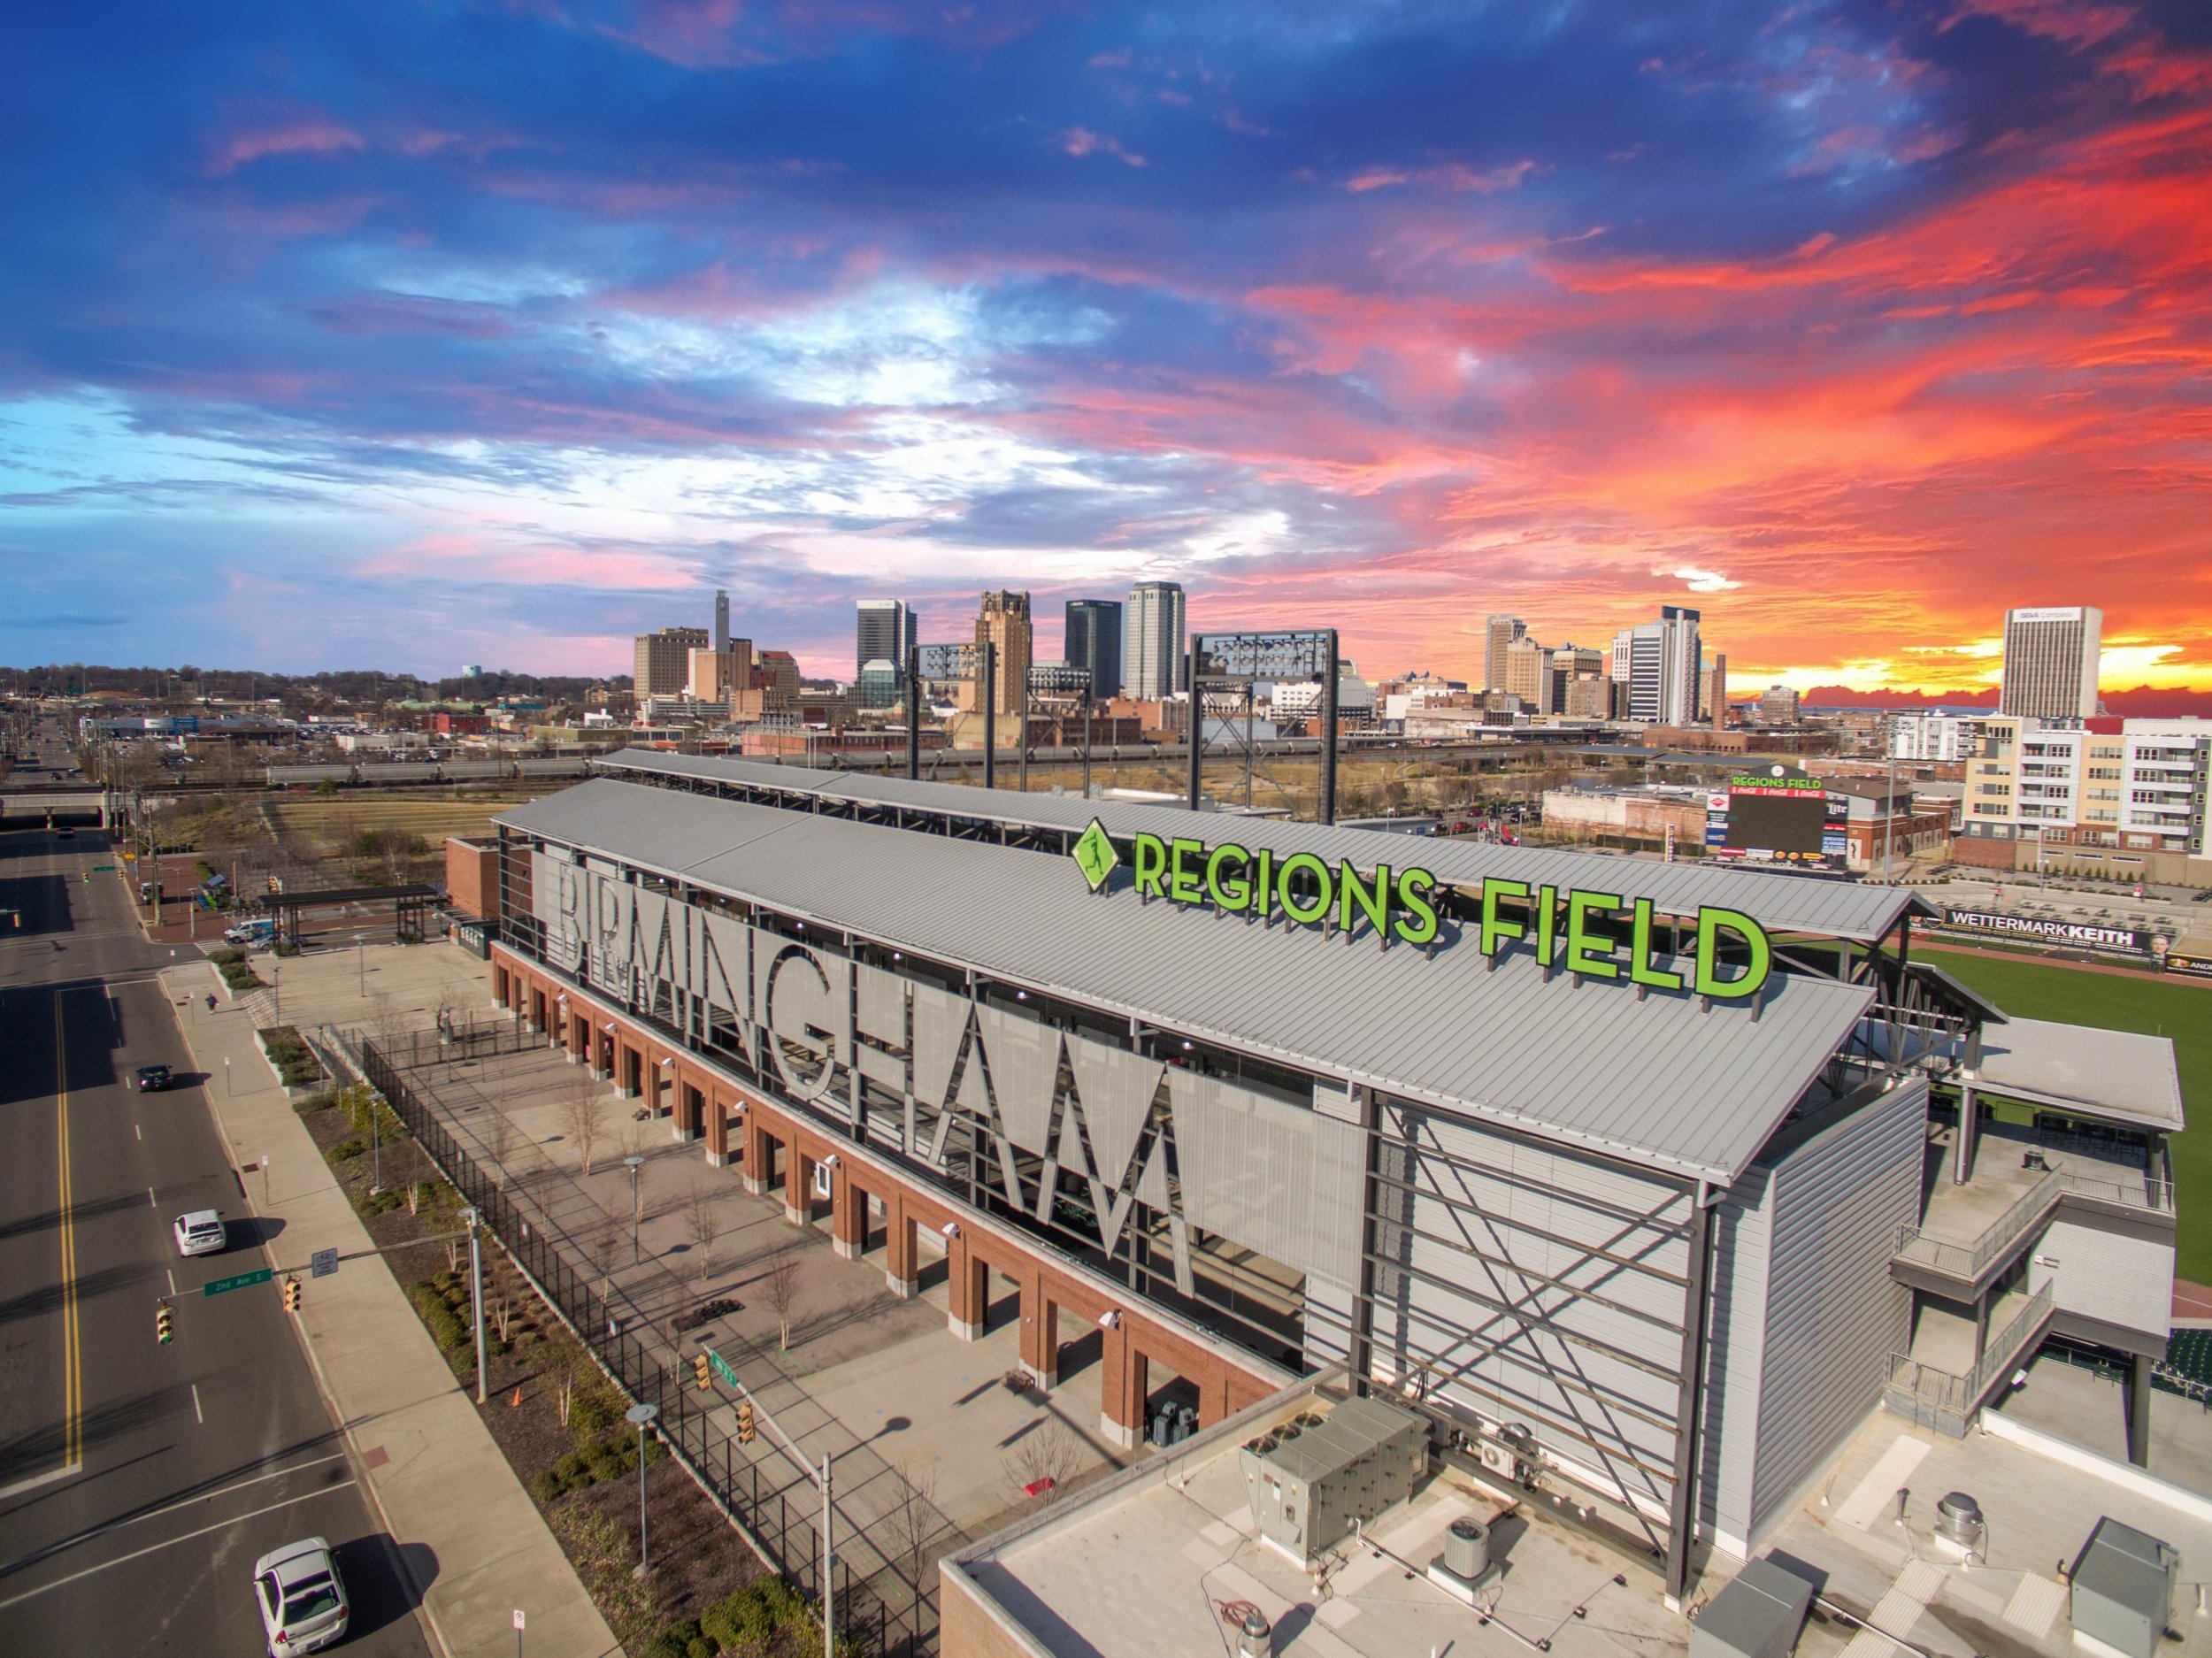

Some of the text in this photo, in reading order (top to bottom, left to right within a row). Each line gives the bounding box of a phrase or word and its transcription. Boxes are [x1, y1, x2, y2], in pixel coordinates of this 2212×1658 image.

[1732, 776, 1823, 789] REGIONS FIELD
[1827, 802, 1847, 815] Lite
[1134, 832, 1770, 999] REGIONS FIELD
[1951, 910, 2069, 937] WETTERMARK
[2068, 925, 2133, 946] KEITH
[559, 862, 1194, 1298] BIRMINGHAM
[216, 1282, 231, 1292] 2nd
[236, 1277, 250, 1286] Ave
